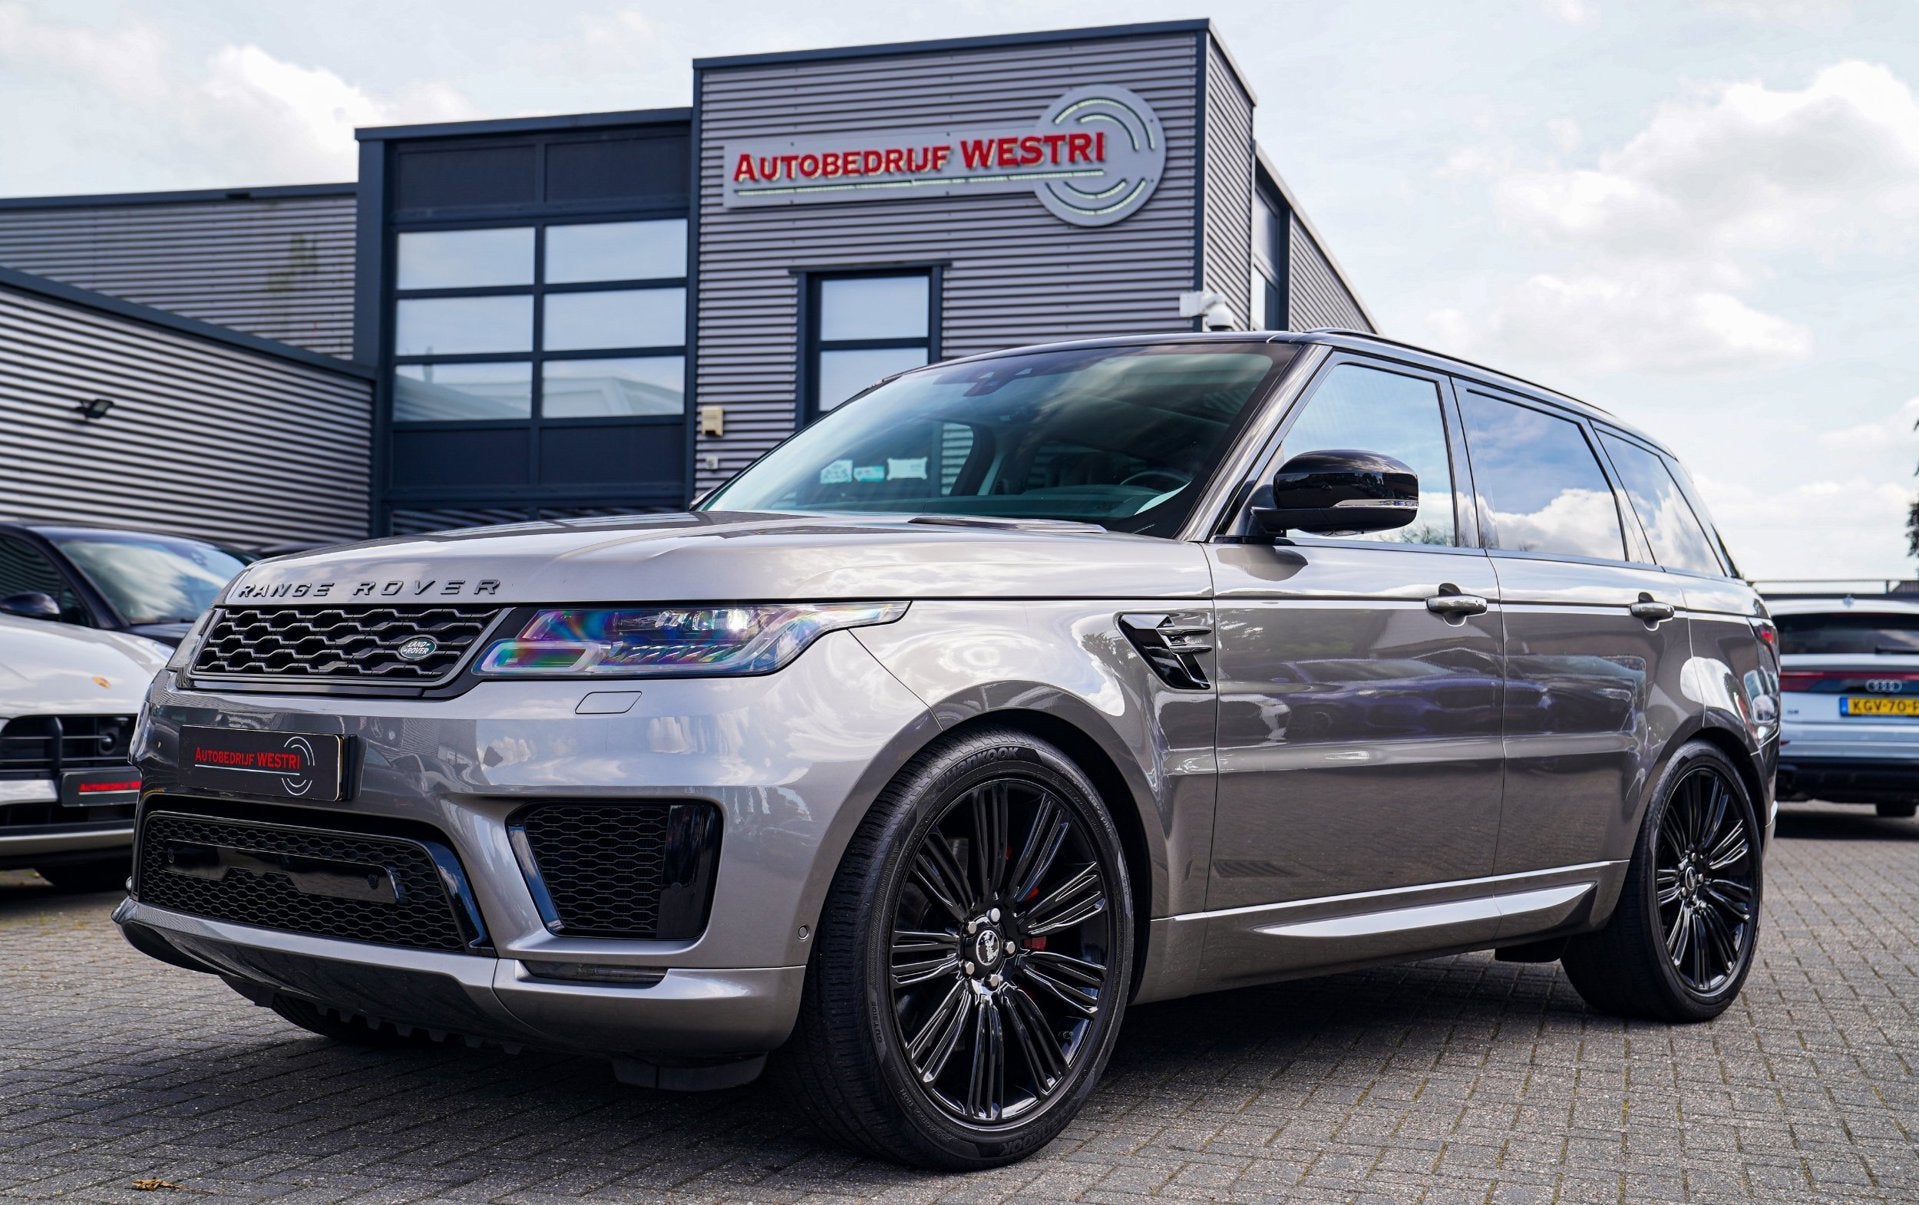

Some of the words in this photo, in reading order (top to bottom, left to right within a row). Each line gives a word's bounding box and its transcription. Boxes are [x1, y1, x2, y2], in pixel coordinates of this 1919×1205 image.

[733, 146, 950, 182] AUTOBEDRIJF
[960, 132, 1105, 168] WESTRI
[238, 582, 335, 598] RANGE
[352, 579, 501, 597] ROVER
[194, 746, 255, 766] AUTOBEDRIJF
[257, 752, 302, 770] WESTRI
